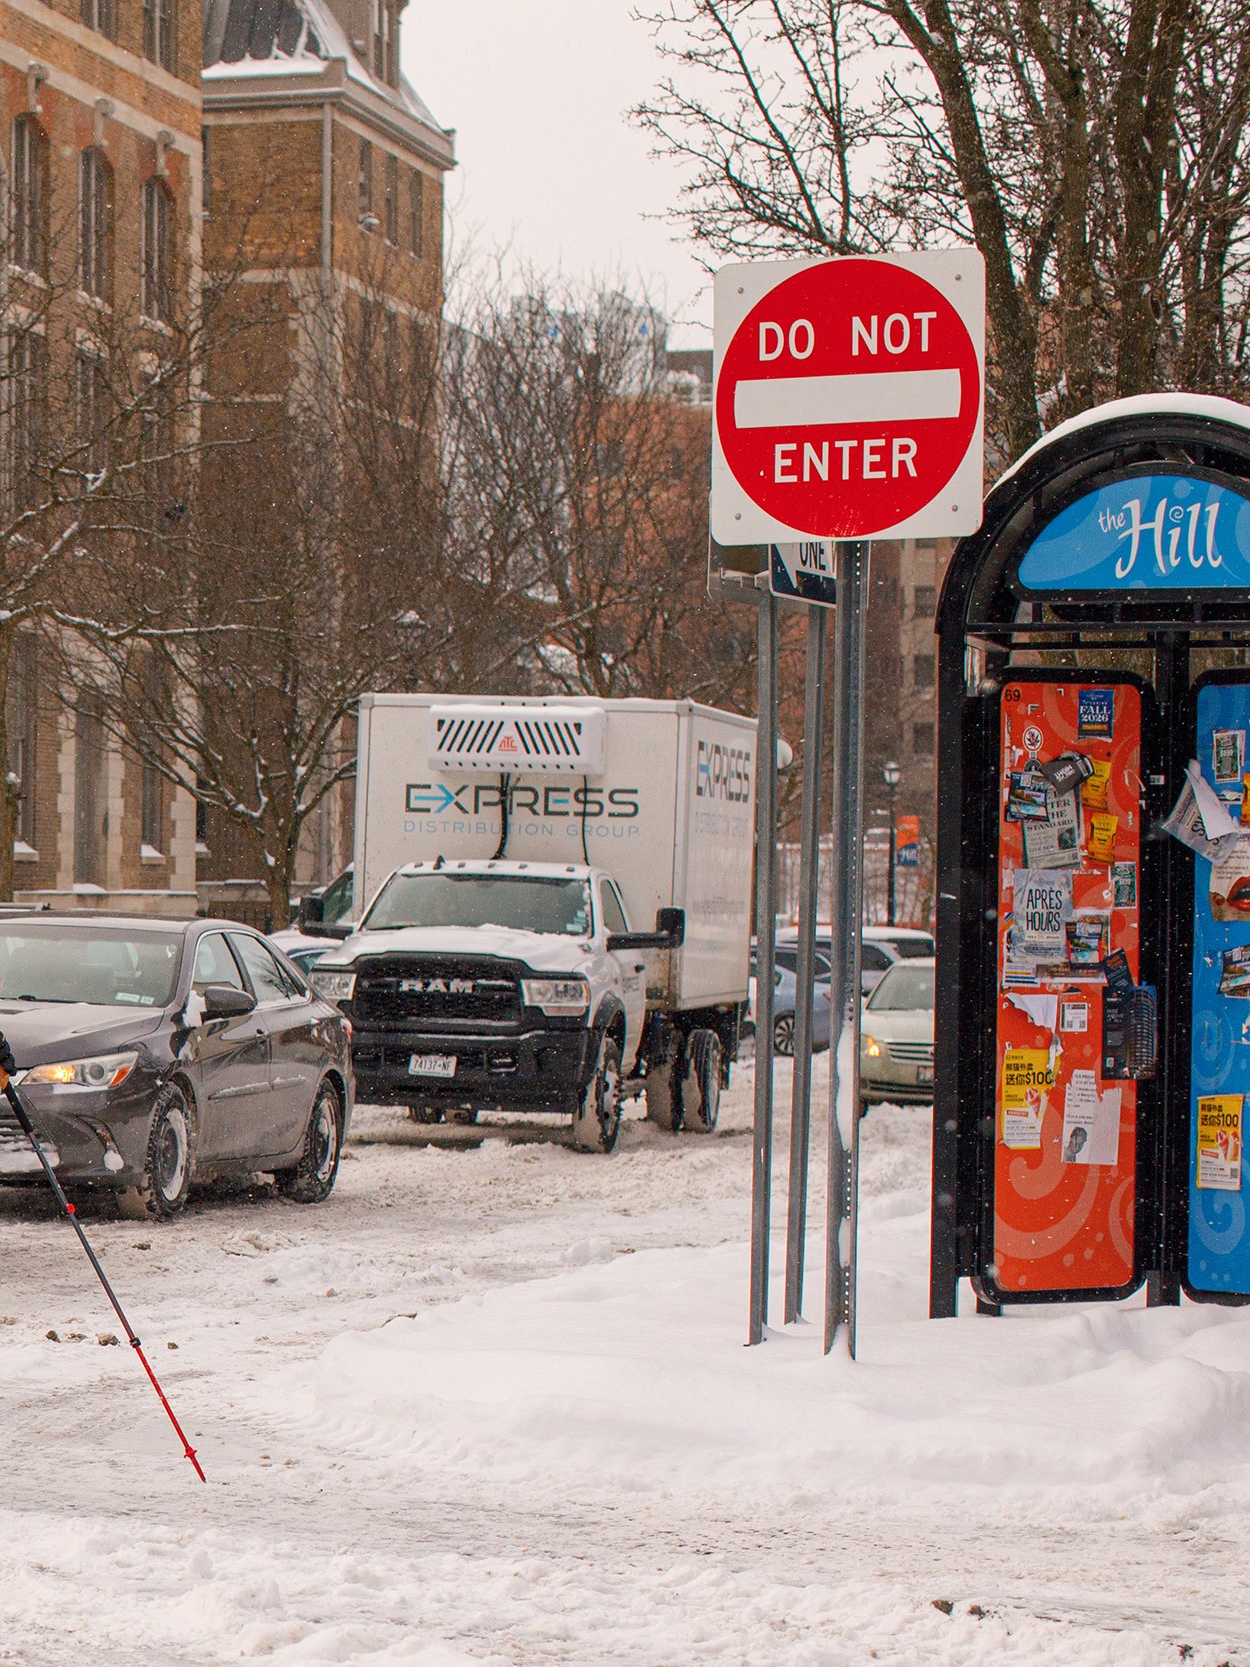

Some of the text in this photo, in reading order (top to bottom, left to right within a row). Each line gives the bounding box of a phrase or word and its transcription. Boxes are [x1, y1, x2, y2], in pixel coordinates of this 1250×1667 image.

[758, 311, 937, 361] DO NOT
[774, 437, 918, 484] ENTER
[1097, 497, 1223, 579] the Hill
[799, 542, 827, 571] ONE
[1004, 689, 1021, 702] 69
[1079, 705, 1111, 715] FALL
[1081, 713, 1109, 723] 2026
[696, 740, 751, 803] EXPRESS
[405, 783, 639, 818] EXPRESS
[404, 819, 640, 838] DISTRIBUTION GROUP
[1027, 818, 1073, 832] STANDARD
[1026, 887, 1063, 910] APRÈS
[1025, 911, 1061, 932] HOURS
[399, 977, 474, 993] RAM
